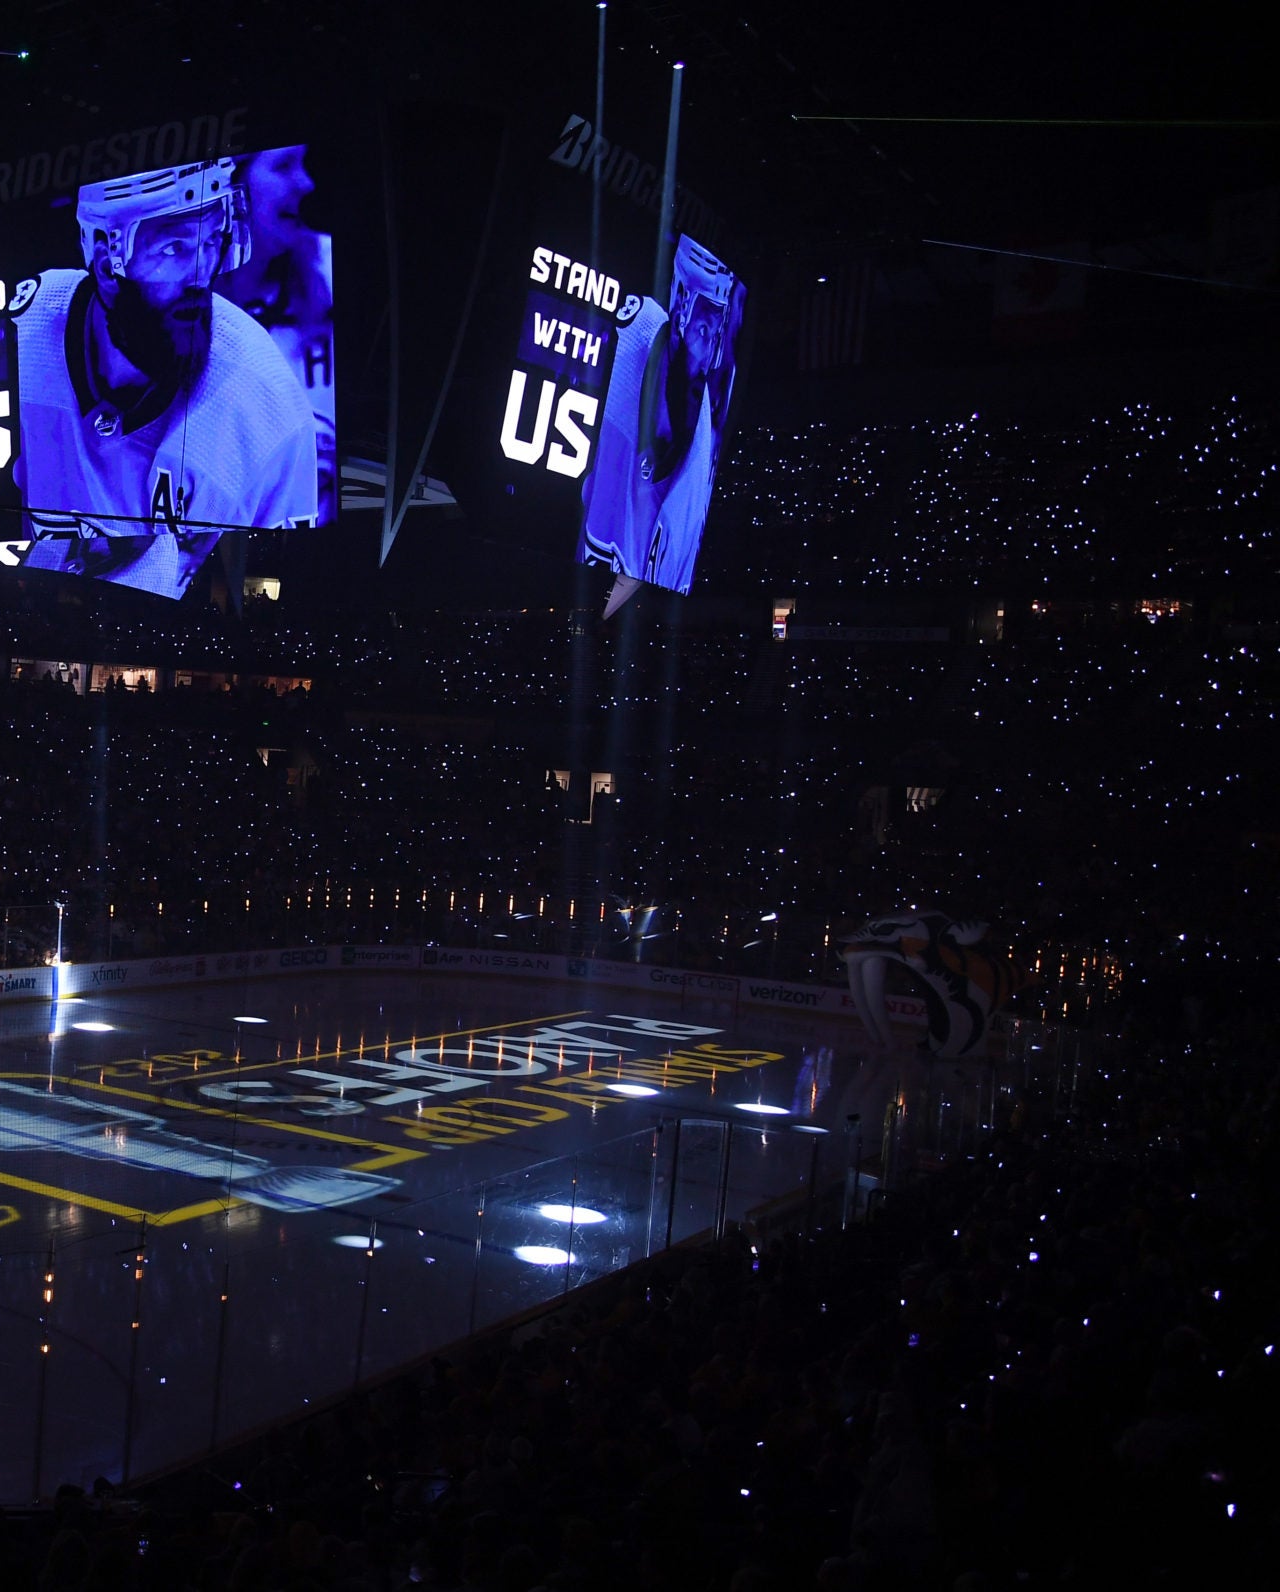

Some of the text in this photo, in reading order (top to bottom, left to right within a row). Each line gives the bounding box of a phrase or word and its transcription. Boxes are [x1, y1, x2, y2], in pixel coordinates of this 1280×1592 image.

[530, 245, 620, 313] STAND
[533, 311, 602, 368] WITH
[500, 369, 598, 480] US
[280, 950, 327, 967] GEICO
[470, 954, 550, 970] NISSAN
[91, 965, 128, 984] xfinity
[650, 969, 694, 986] Great
[749, 984, 818, 1006] verizon
[841, 995, 929, 1018] HNDA
[197, 1013, 726, 1117] PLAYOFFS
[381, 1042, 786, 1145] STANLEY CUP
